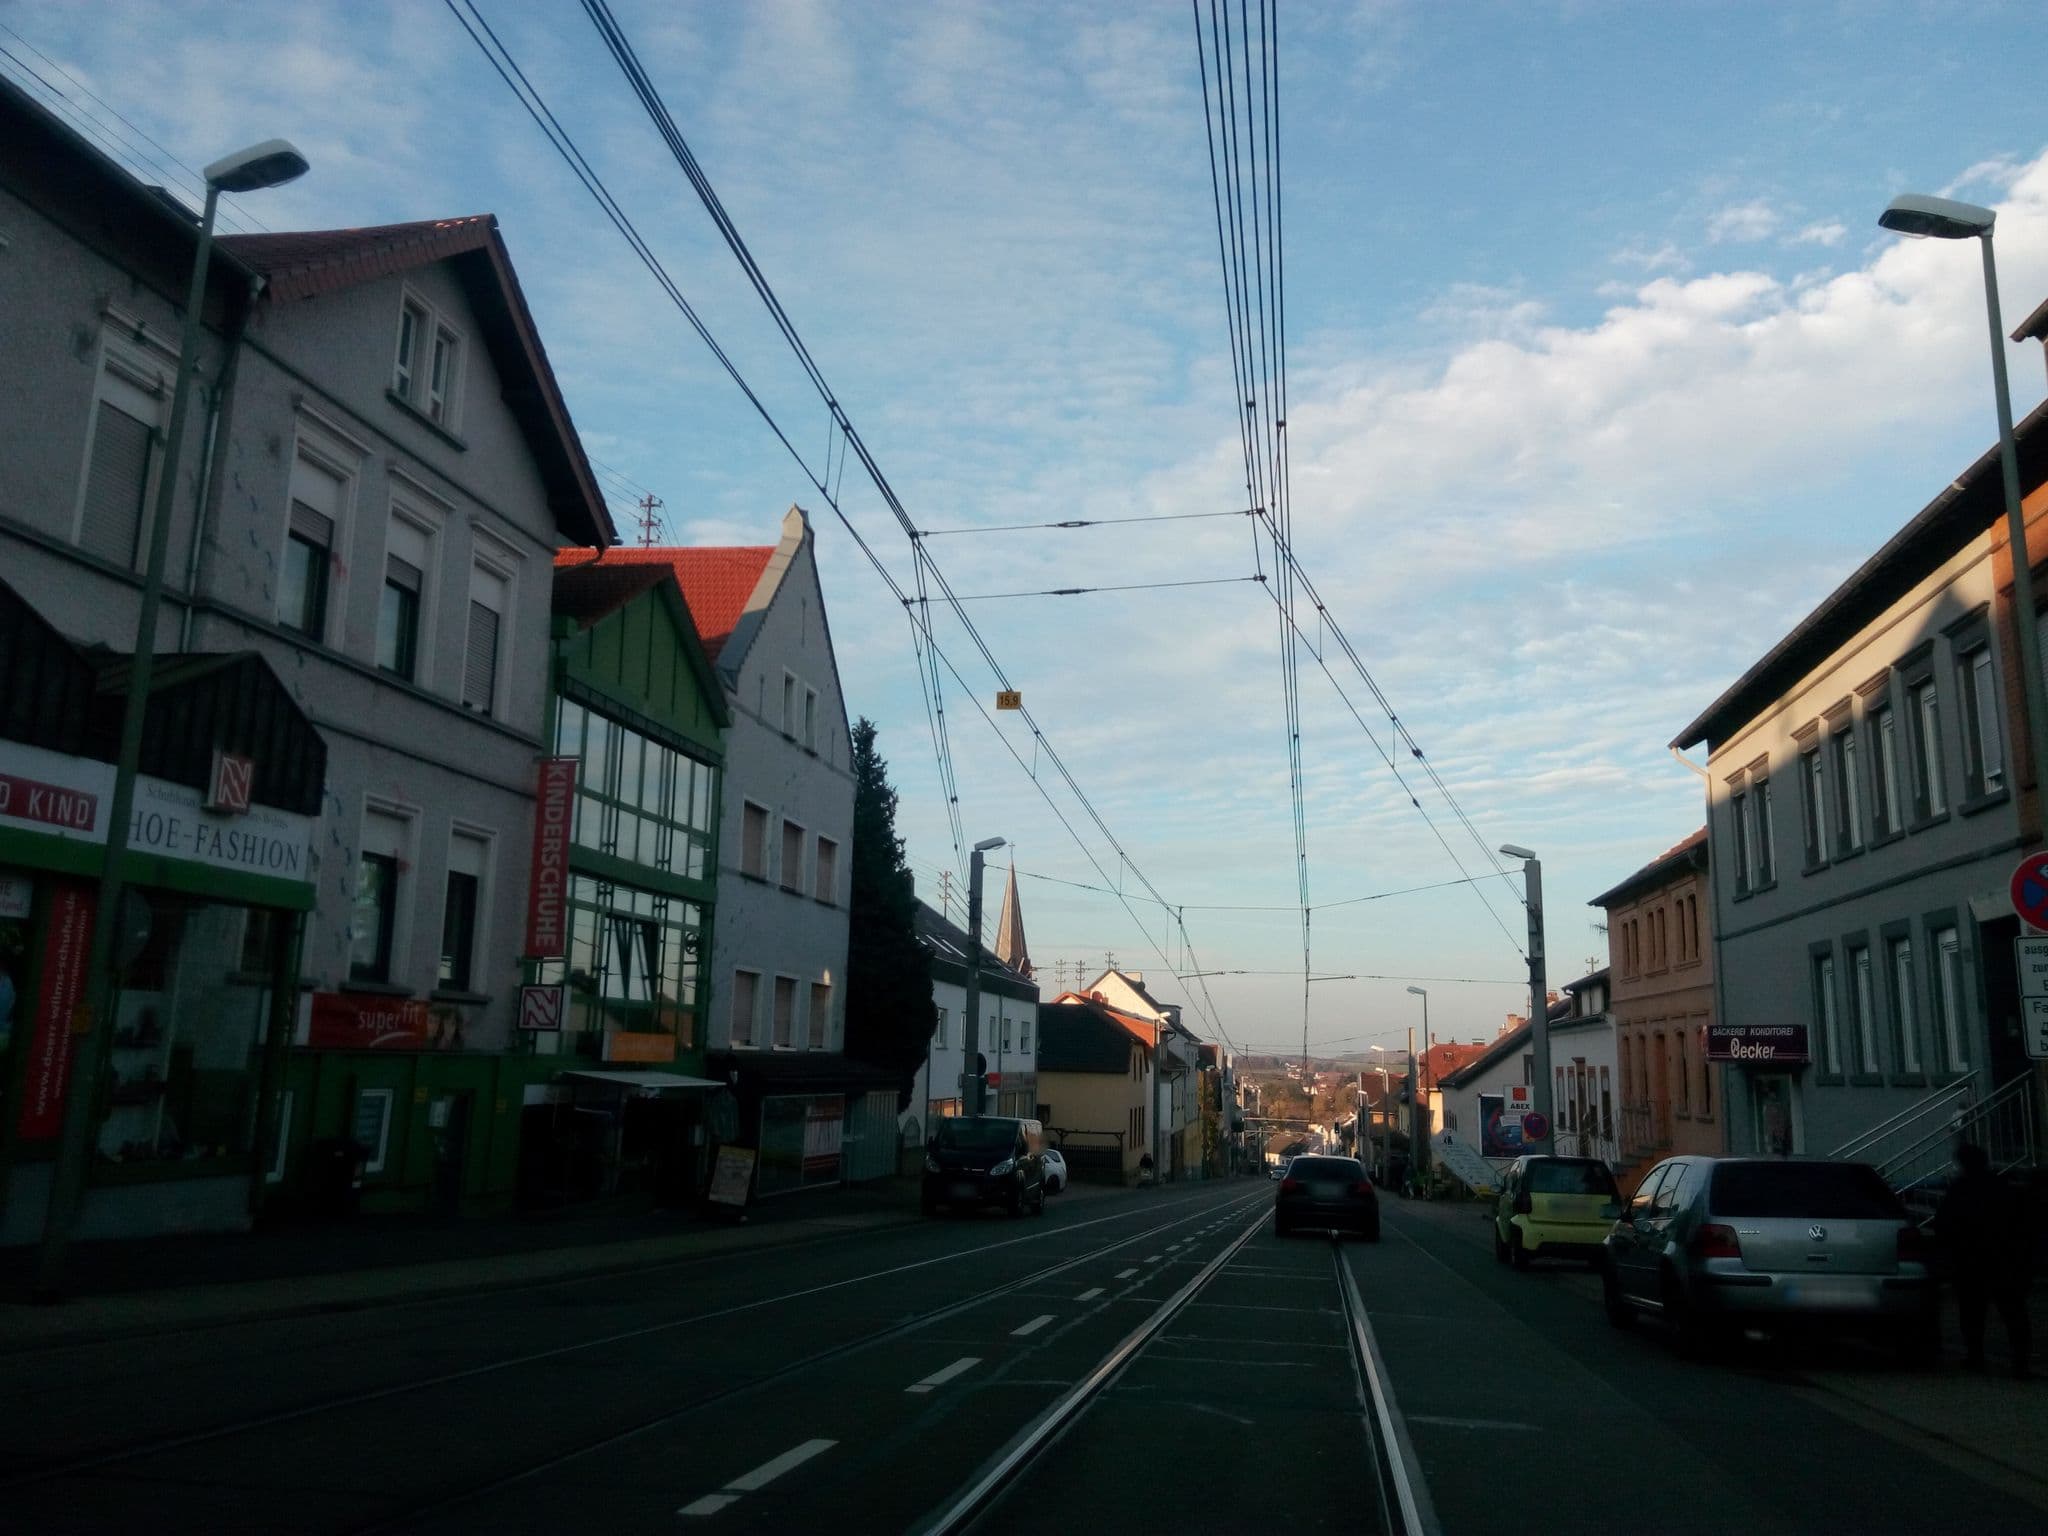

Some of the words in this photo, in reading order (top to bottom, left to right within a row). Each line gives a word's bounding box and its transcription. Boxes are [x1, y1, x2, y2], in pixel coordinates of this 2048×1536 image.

[28, 788, 90, 825] KIND
[130, 810, 300, 873] HOE-FASHION
[534, 764, 568, 947] KINDERSCHUHE
[1730, 1037, 1776, 1060] Becker
